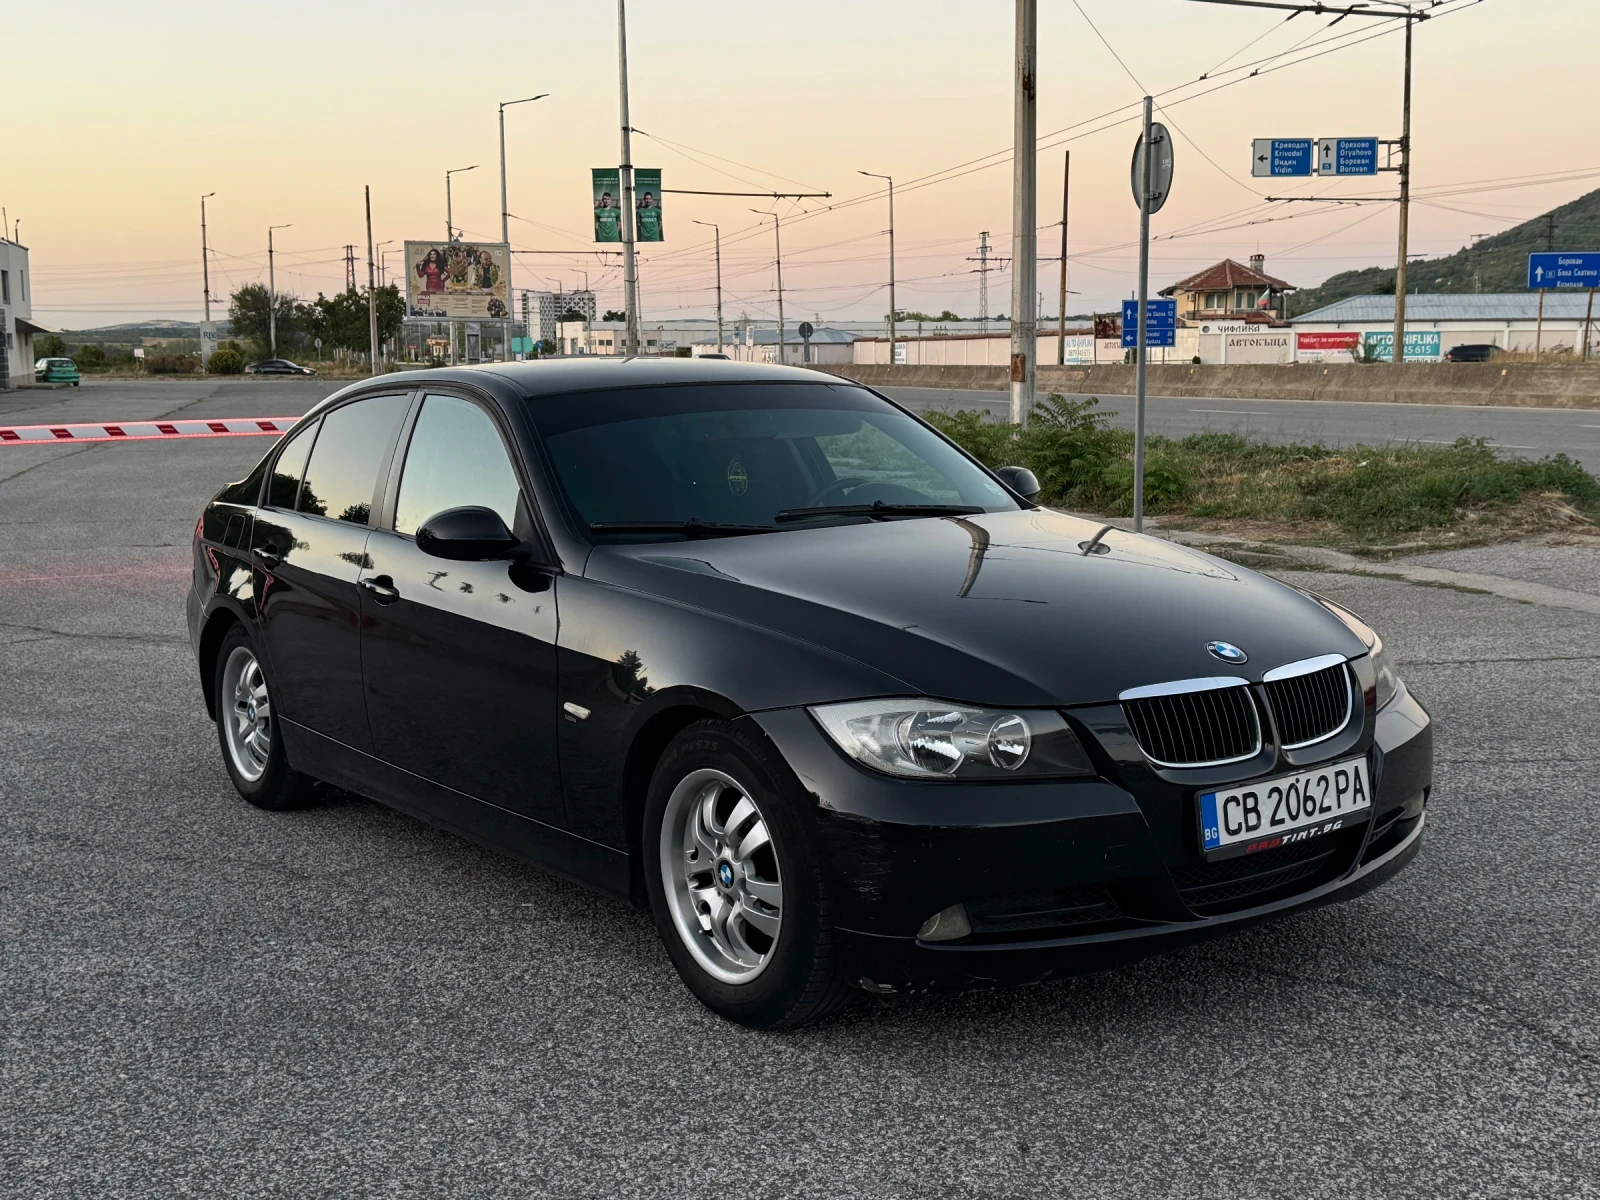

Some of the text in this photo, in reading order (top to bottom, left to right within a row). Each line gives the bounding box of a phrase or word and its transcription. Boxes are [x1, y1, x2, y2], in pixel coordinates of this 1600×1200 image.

[1274, 141, 1308, 150] Криводол
[1340, 141, 1370, 149] Оряхово
[1340, 149, 1372, 157] Oryahovo
[1274, 158, 1297, 166] Видин
[1340, 158, 1370, 166] Борован
[1558, 257, 1583, 266] Борован
[1557, 268, 1572, 276] Бяла
[1573, 268, 1598, 276] Слатина
[1229, 338, 1288, 348] АВТОКЪЩА
[1367, 334, 1439, 345] AUTO HIFLIKA
[1403, 346, 1413, 354] 45
[1414, 345, 1432, 354] 615
[1204, 765, 1366, 841] BG CB 2062 PA
